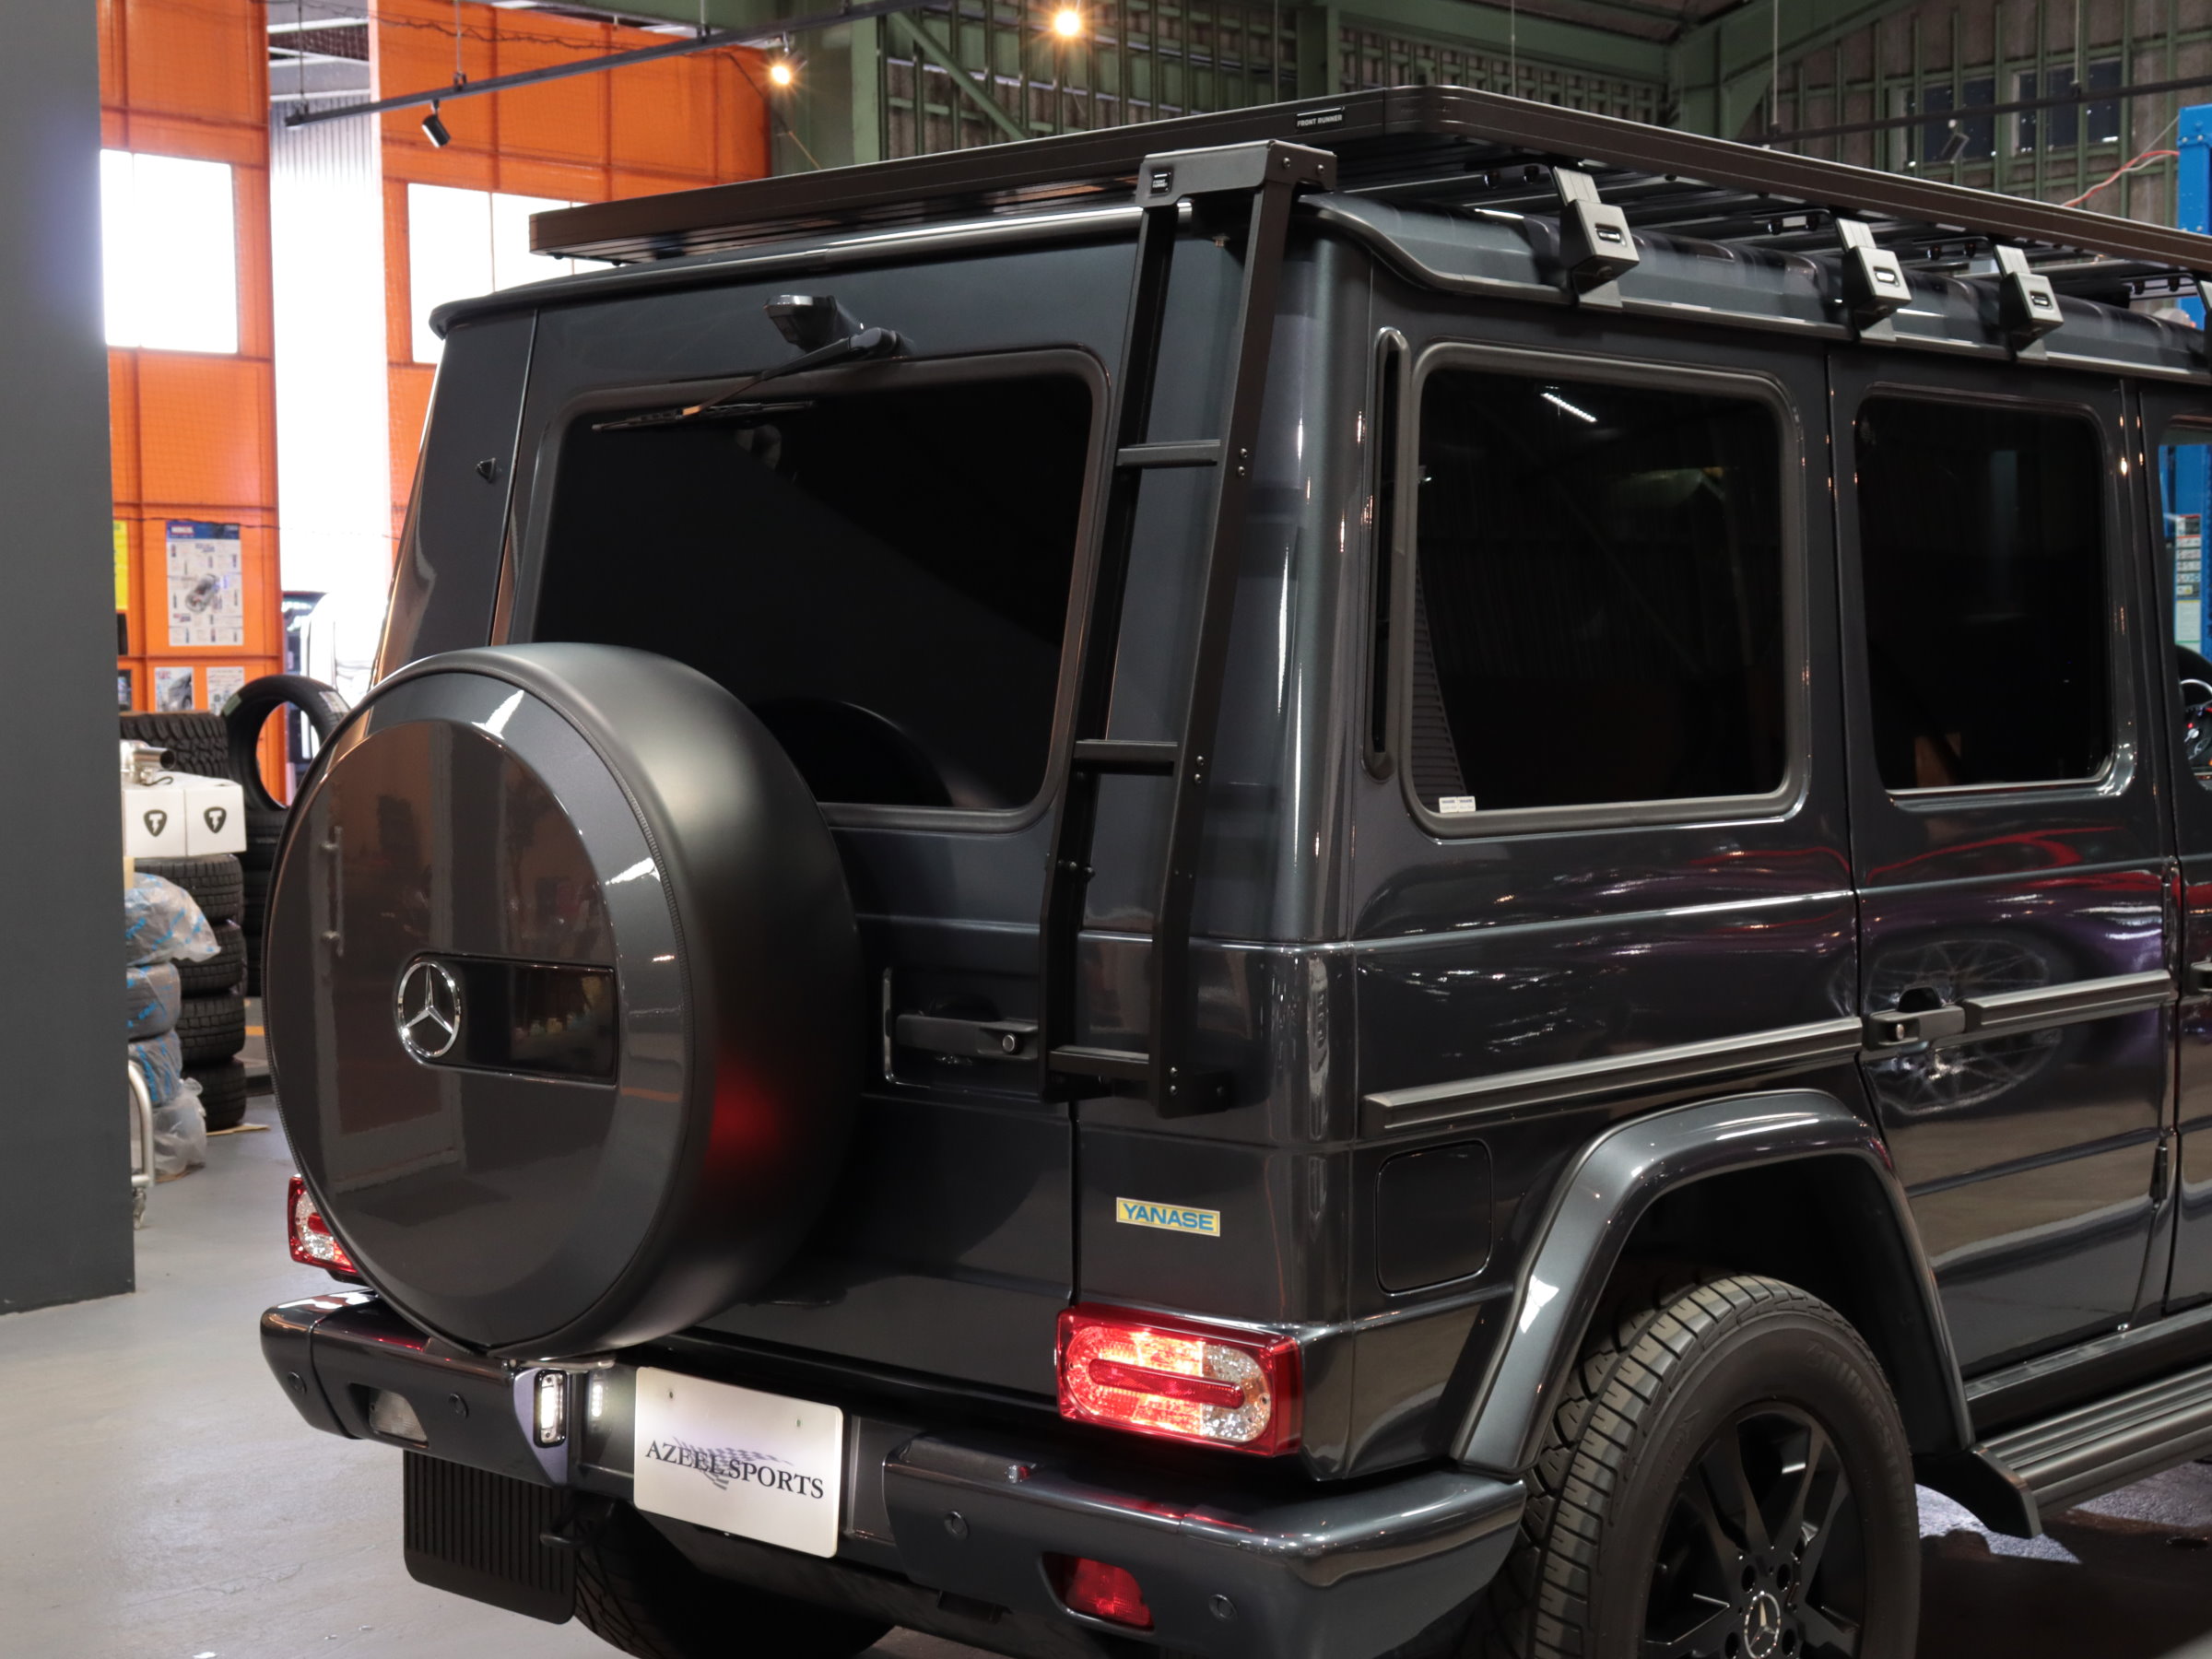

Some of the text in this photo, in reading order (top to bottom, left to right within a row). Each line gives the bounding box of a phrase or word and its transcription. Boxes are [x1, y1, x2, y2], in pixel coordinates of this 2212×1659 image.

[1297, 114, 1342, 127] FRONT RUNNER
[1123, 1203, 1214, 1231] YANASE
[645, 1439, 825, 1500] AZEEL SPORTS
